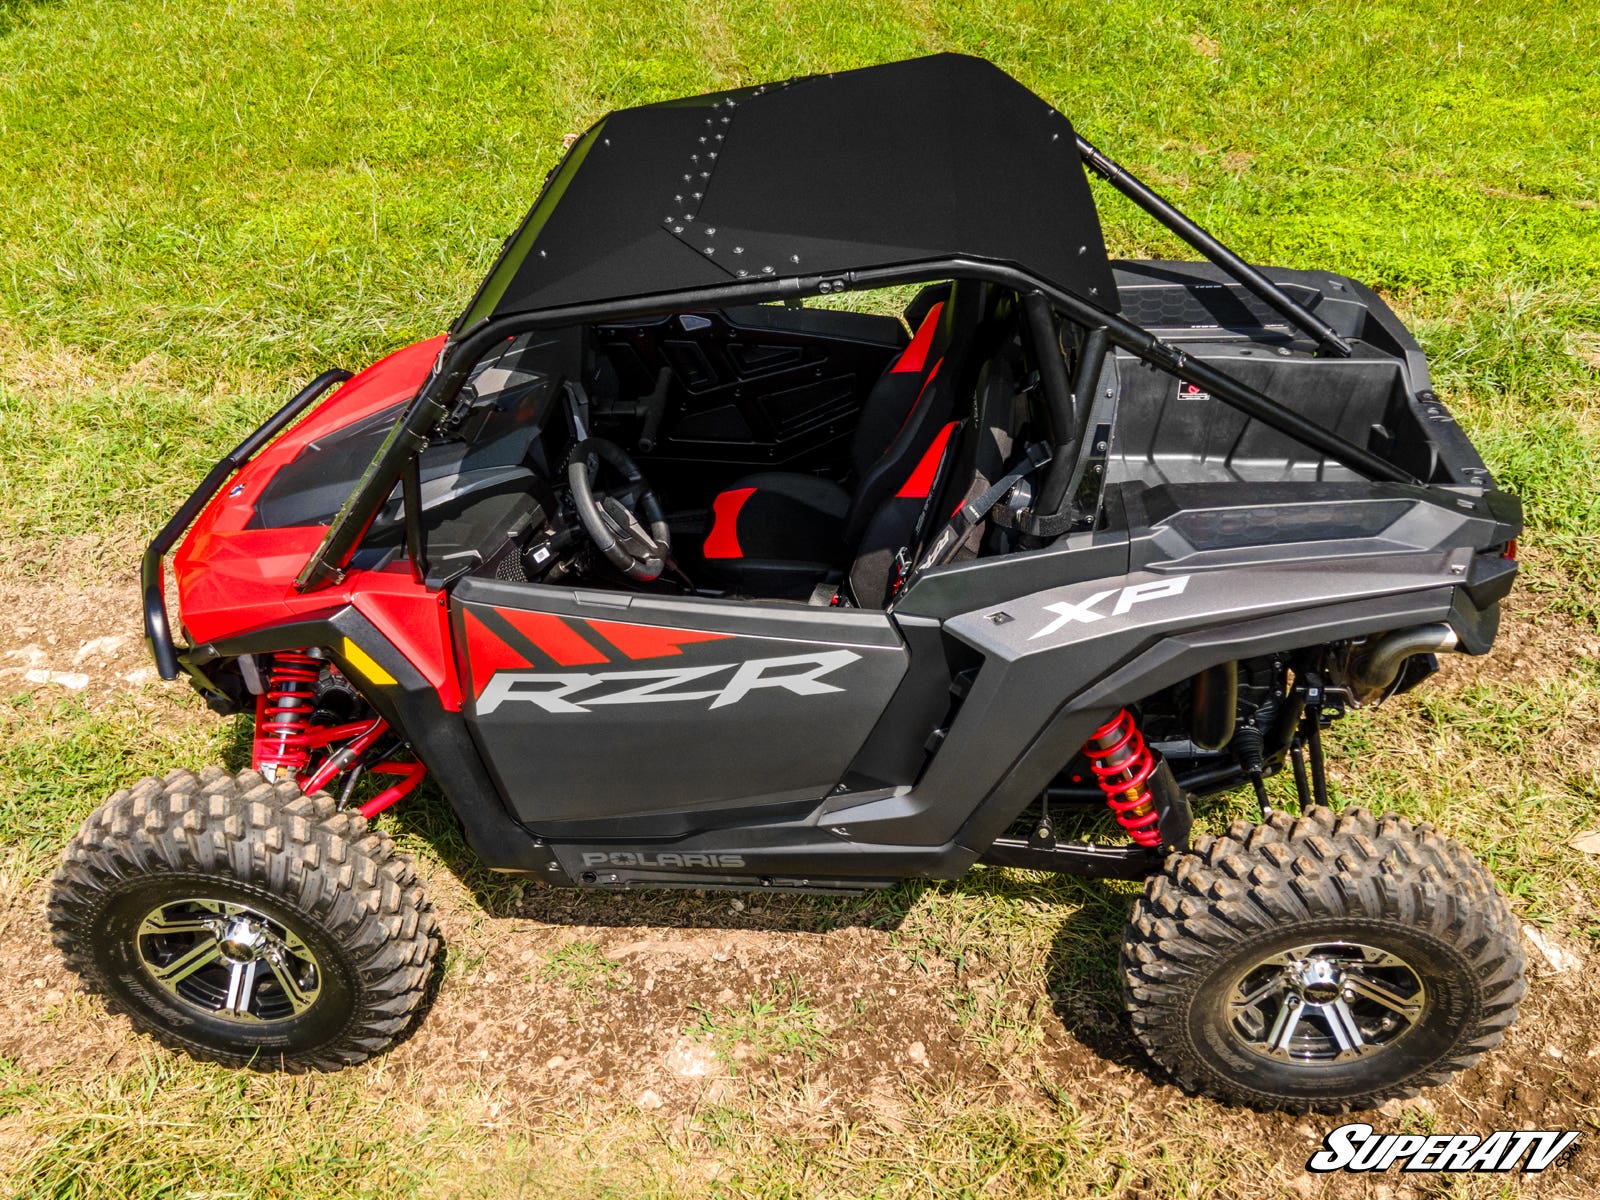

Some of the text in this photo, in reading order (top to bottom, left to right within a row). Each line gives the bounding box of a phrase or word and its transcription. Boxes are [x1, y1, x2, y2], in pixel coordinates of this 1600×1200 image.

[1026, 575, 1191, 641] XP
[476, 649, 863, 716] RZR
[582, 852, 746, 868] POLARIS
